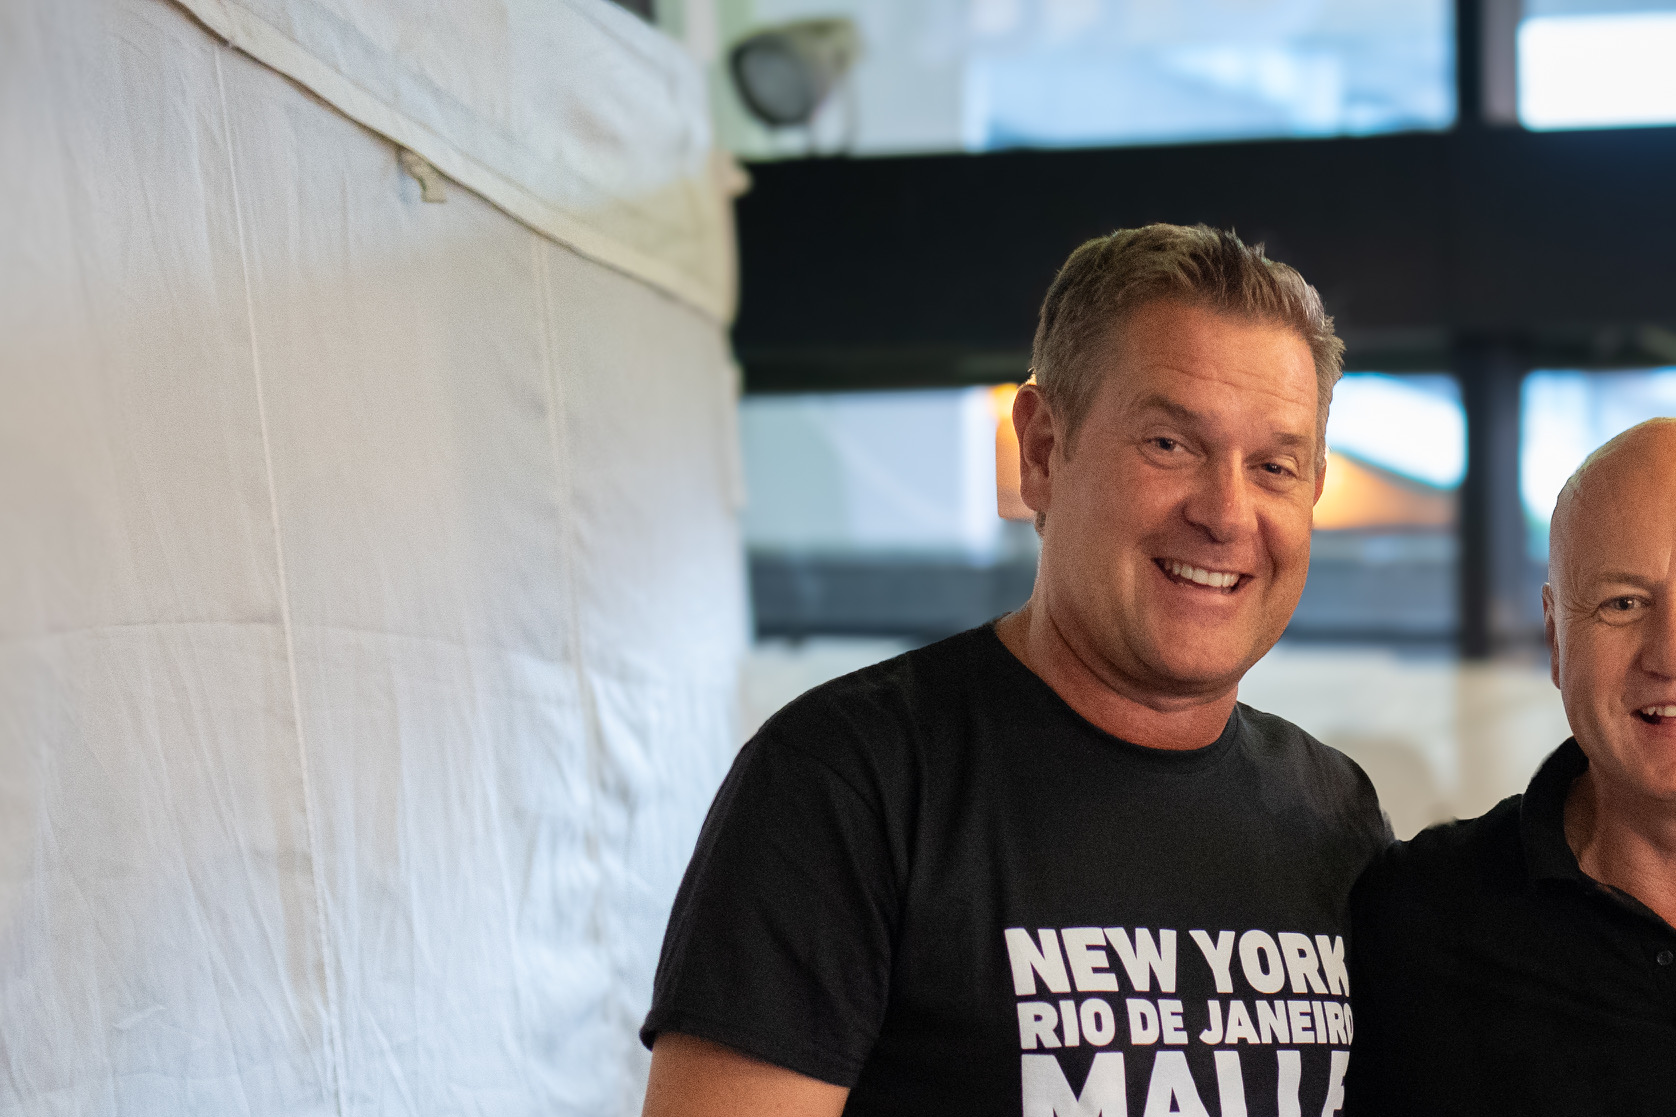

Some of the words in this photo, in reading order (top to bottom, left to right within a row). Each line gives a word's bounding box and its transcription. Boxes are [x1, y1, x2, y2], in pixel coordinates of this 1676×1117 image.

[1004, 927, 1177, 996] NEW
[1188, 929, 1350, 997] YORK
[1017, 998, 1115, 1050] RIO
[1126, 998, 1188, 1046] DE
[1199, 999, 1354, 1046] JANEIRO
